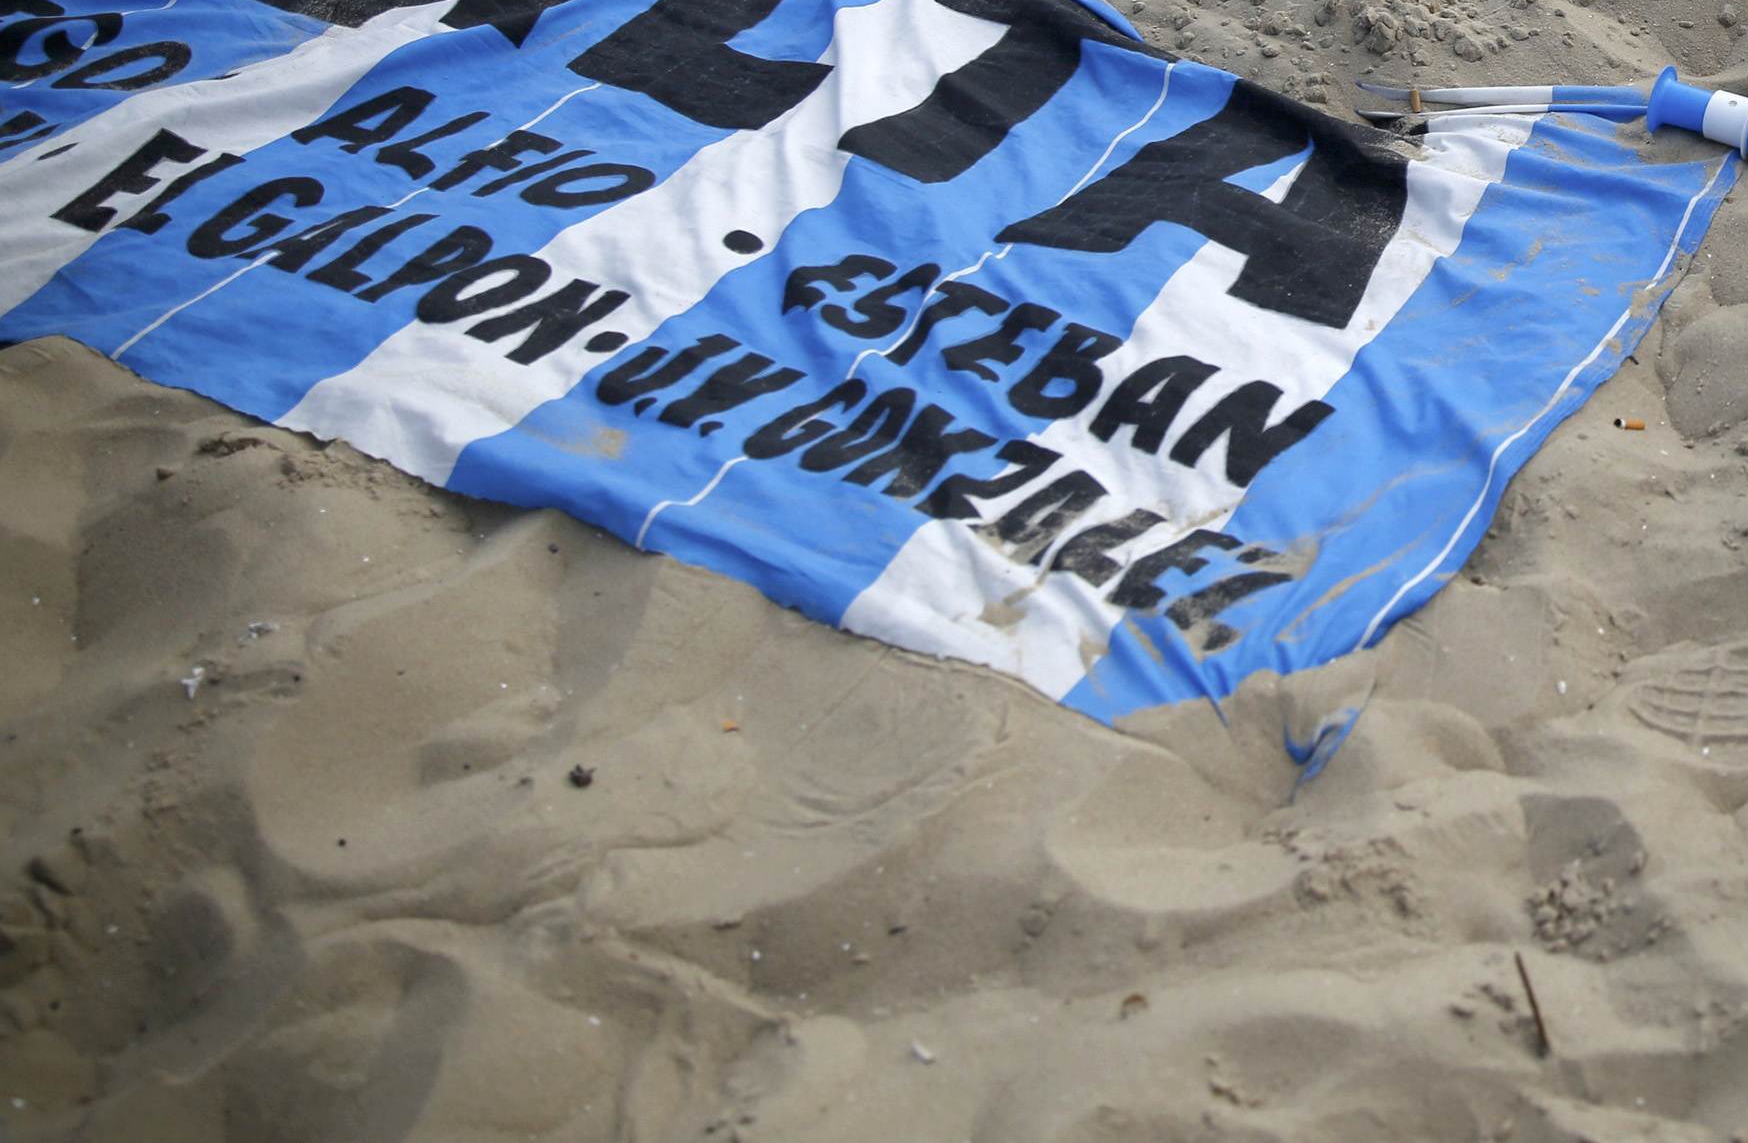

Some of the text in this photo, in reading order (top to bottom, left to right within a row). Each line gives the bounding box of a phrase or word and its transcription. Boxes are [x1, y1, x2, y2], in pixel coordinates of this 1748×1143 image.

[50, 128, 247, 236] EL
[290, 85, 656, 209] ALFIO
[783, 254, 1336, 488] ESTEBAN
